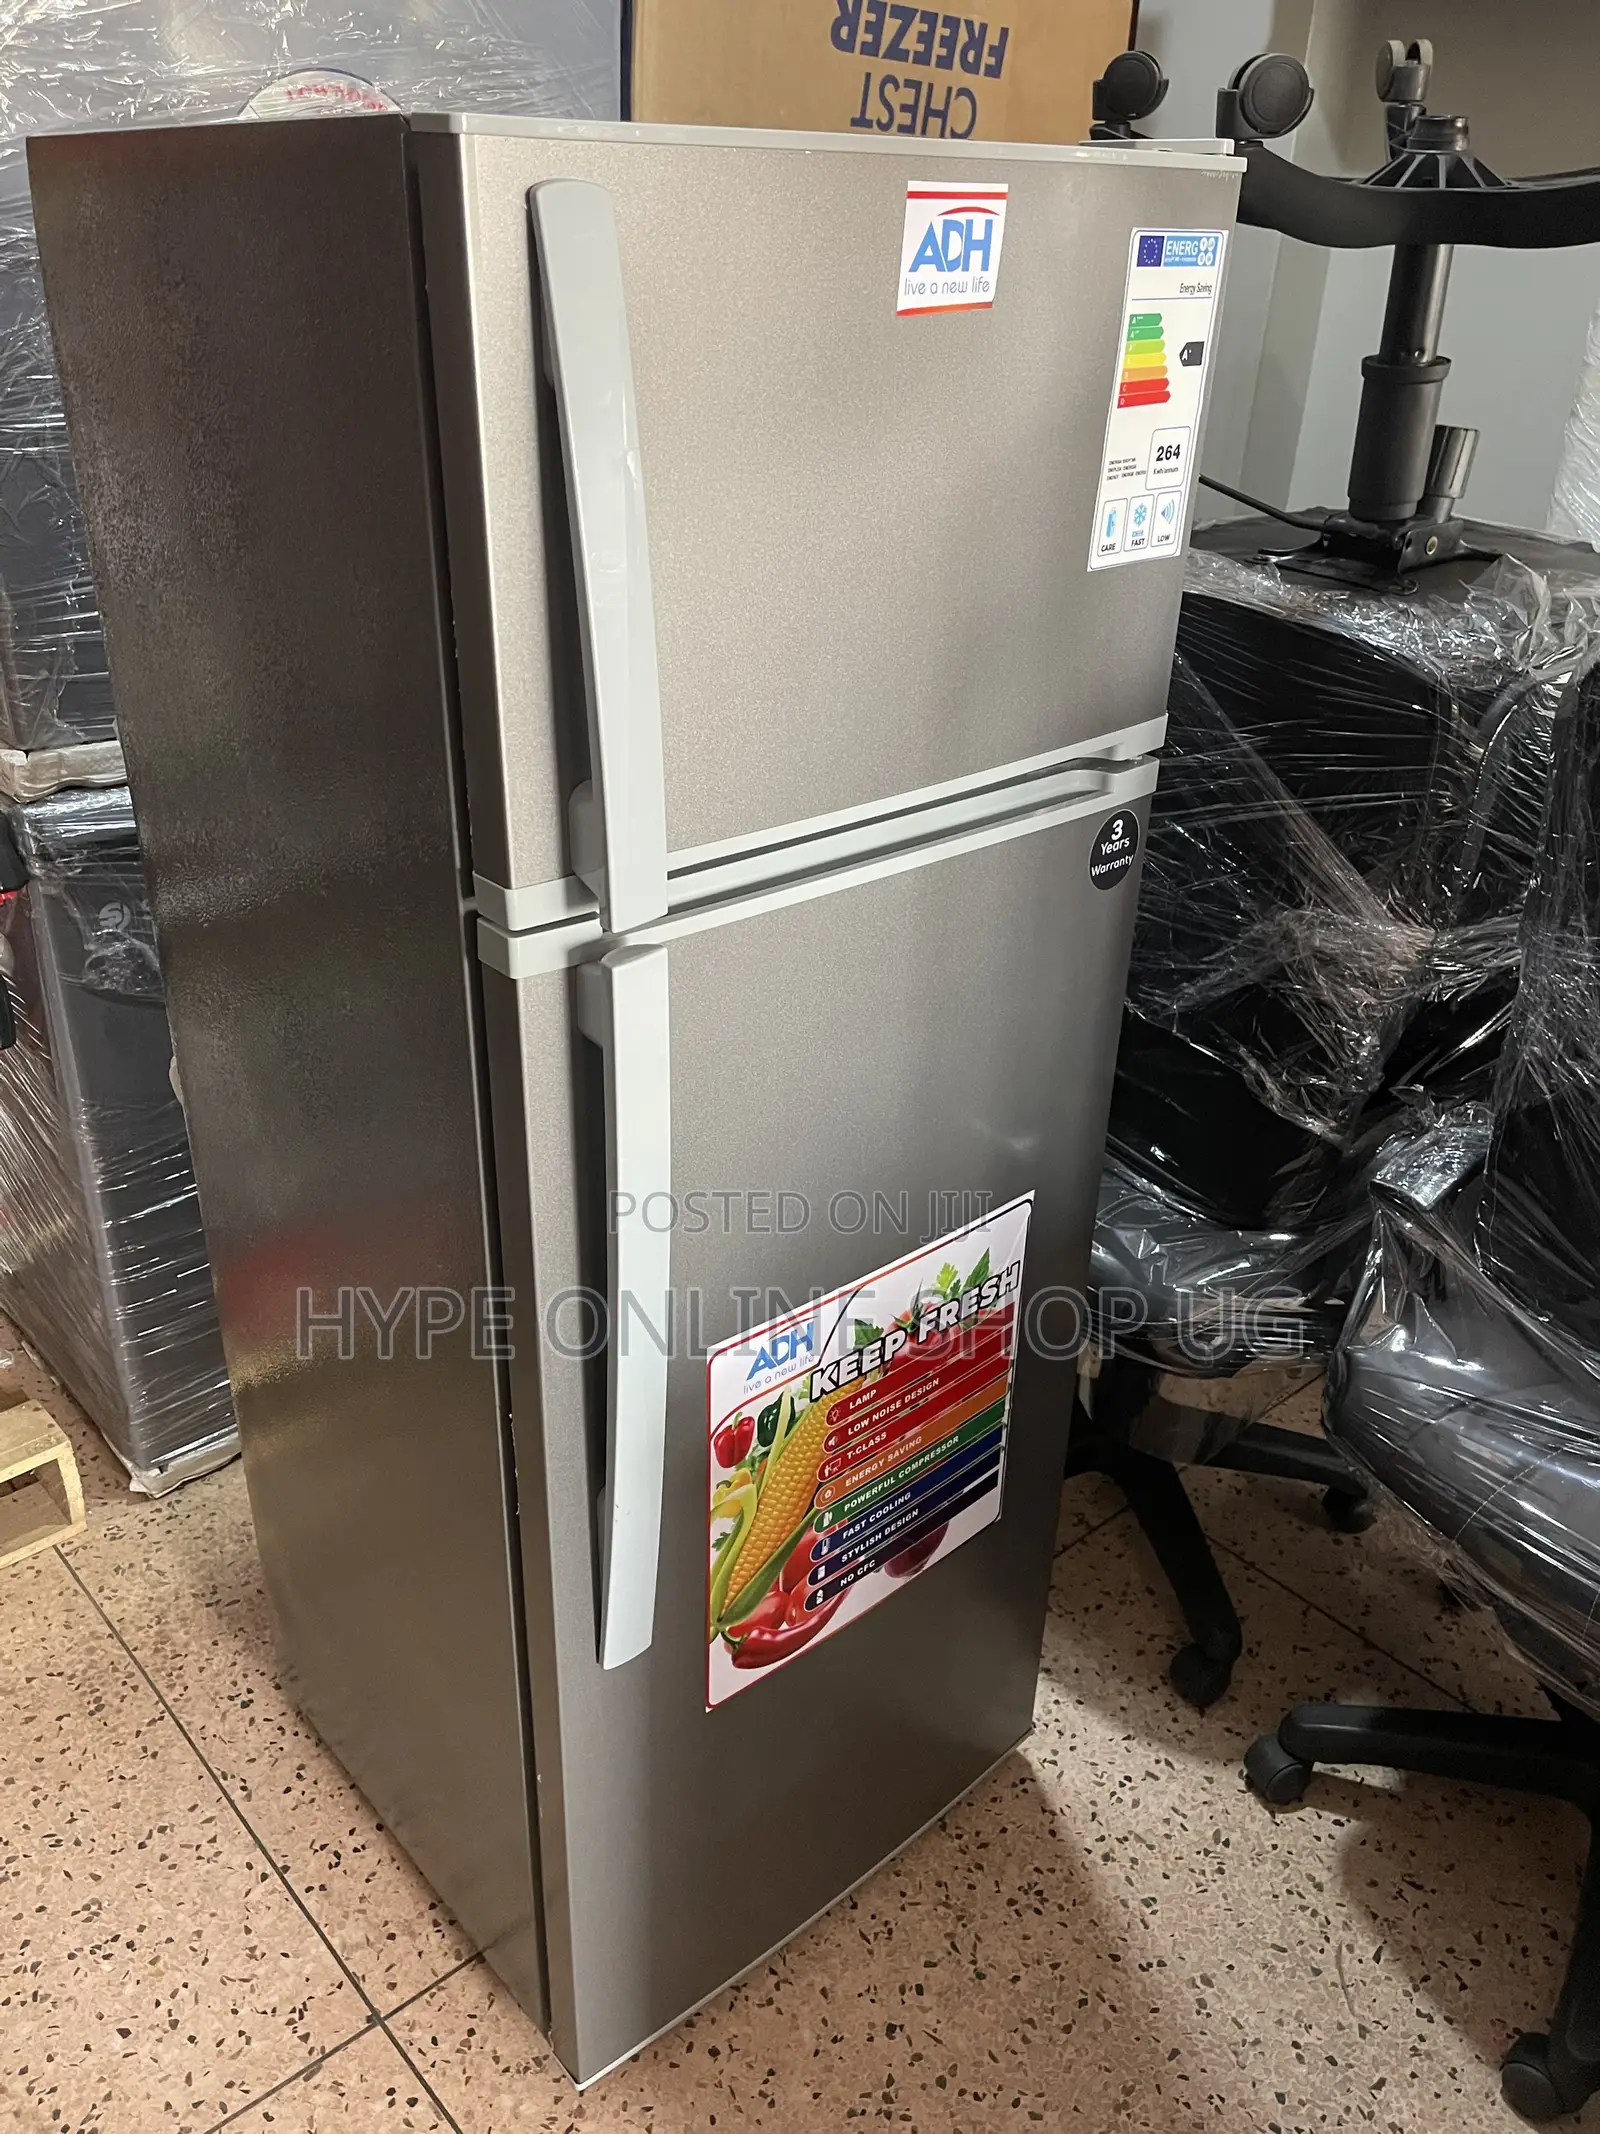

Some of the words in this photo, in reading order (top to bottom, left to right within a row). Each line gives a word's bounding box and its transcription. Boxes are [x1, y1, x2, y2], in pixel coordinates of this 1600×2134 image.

[831, 0, 1009, 79] FREEZER
[849, 71, 977, 139] CHEST
[908, 218, 993, 273] ADH
[1165, 240, 1199, 256] ENERG
[904, 278, 926, 296] live
[930, 282, 938, 295] a
[942, 280, 968, 295] new
[972, 276, 990, 293] life
[1179, 282, 1196, 295] Energy
[1196, 282, 1213, 295] Saving
[1155, 444, 1181, 462] 264
[1101, 542, 1117, 553] CARE
[1131, 538, 1145, 547] FAST
[1157, 533, 1171, 543] LOW
[1111, 818, 1124, 841] 3
[1100, 837, 1130, 856] Years
[1091, 854, 1134, 877] Warranty
[809, 1328, 908, 1403] KEEP
[916, 1259, 1021, 1345] FRESH
[745, 1321, 815, 1382] ADH
[742, 1380, 762, 1395] live
[774, 1362, 797, 1380] new
[799, 1354, 815, 1368] life
[848, 1419, 870, 1436] LOW
[872, 1400, 902, 1423] NOISE
[904, 1377, 940, 1404] DESIGN
[849, 1389, 877, 1410] LAMP
[846, 1431, 888, 1460] T-CLASS
[844, 1476, 896, 1512] POWERFUL
[898, 1435, 960, 1479] COMPRESSOR
[845, 1458, 885, 1487] ENERGY
[887, 1435, 923, 1462] SAVING
[842, 1519, 867, 1540] FAST
[869, 1491, 912, 1523] COOLING
[841, 1532, 882, 1563] STYLISH
[884, 1508, 920, 1535] DESIGN
[840, 1572, 855, 1587] NO
[857, 1559, 877, 1576] CFC
